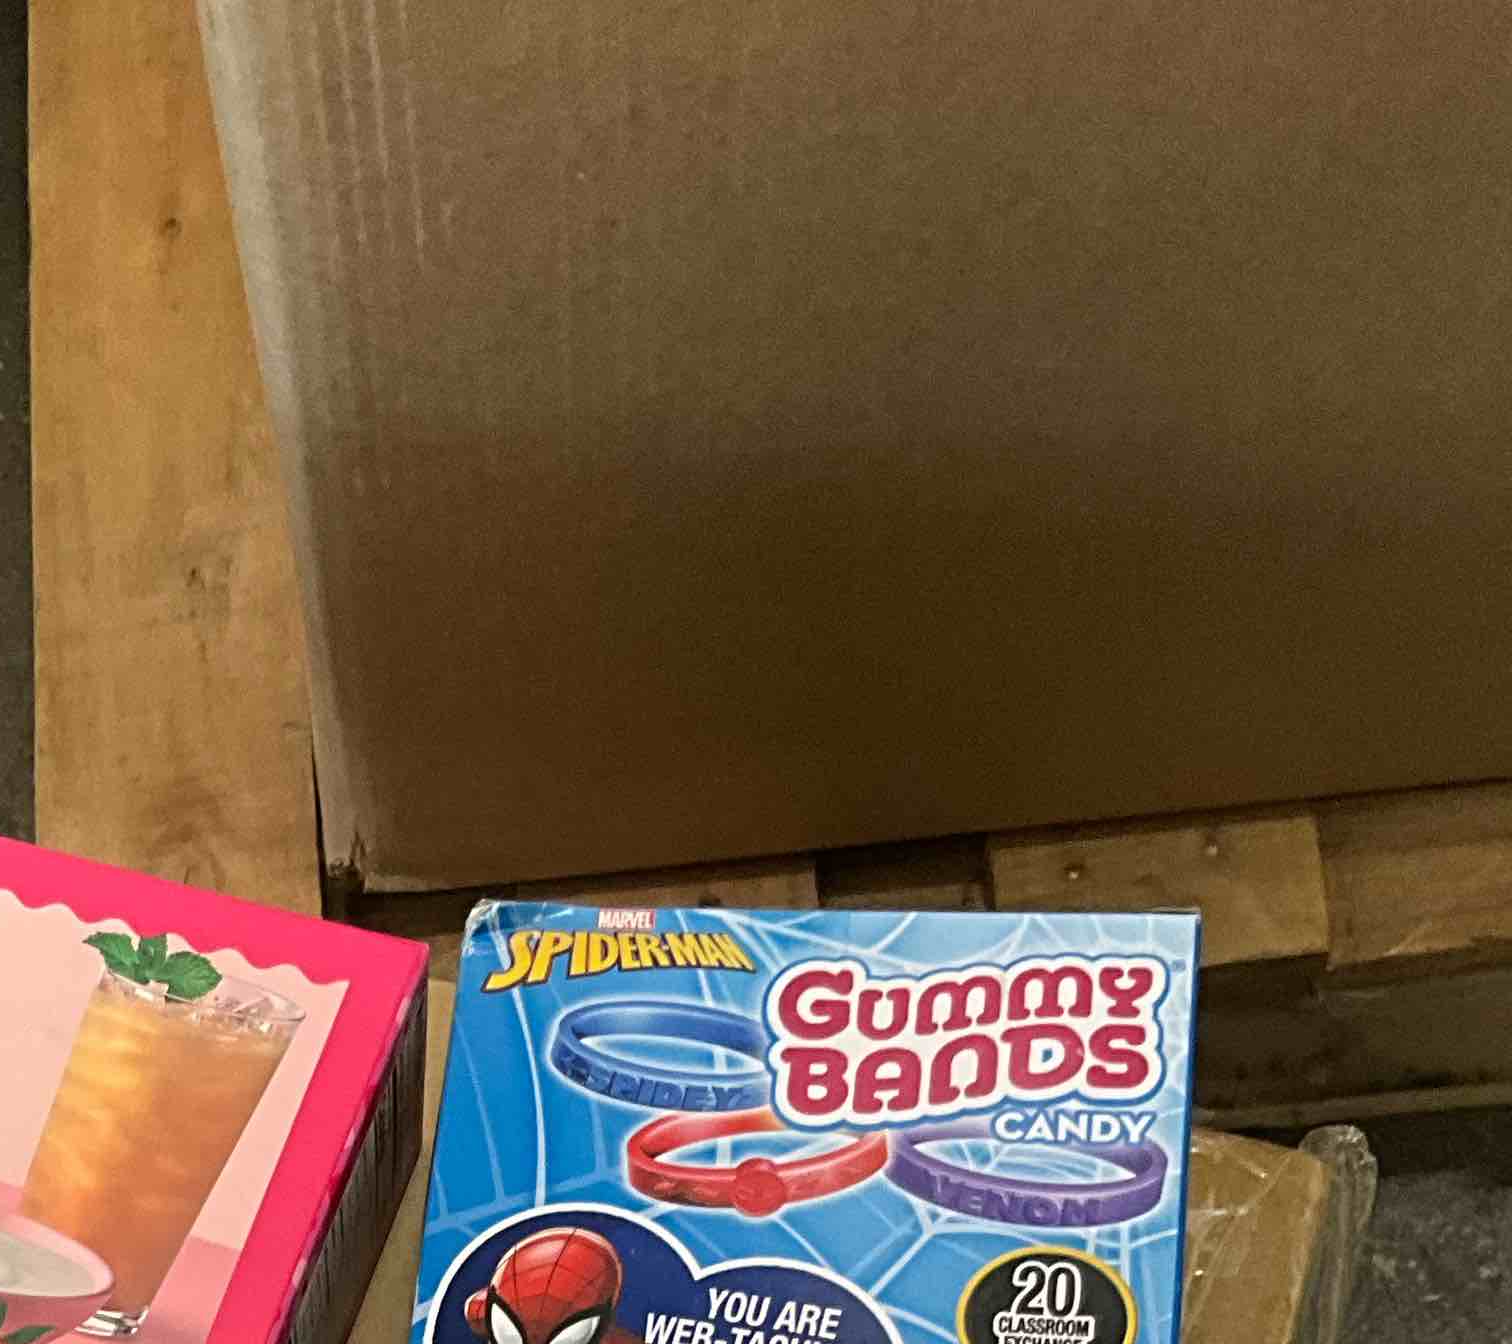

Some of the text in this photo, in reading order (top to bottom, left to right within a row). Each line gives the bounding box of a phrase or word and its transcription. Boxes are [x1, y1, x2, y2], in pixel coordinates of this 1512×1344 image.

[598, 910, 654, 929] MARVEL
[481, 927, 756, 993] SPIDER-MAN
[993, 1111, 1154, 1143] CANDY
[1013, 1263, 1079, 1317] 20
[707, 1287, 842, 1340] YOU ARE
[999, 1316, 1089, 1336] CLASSROOM
